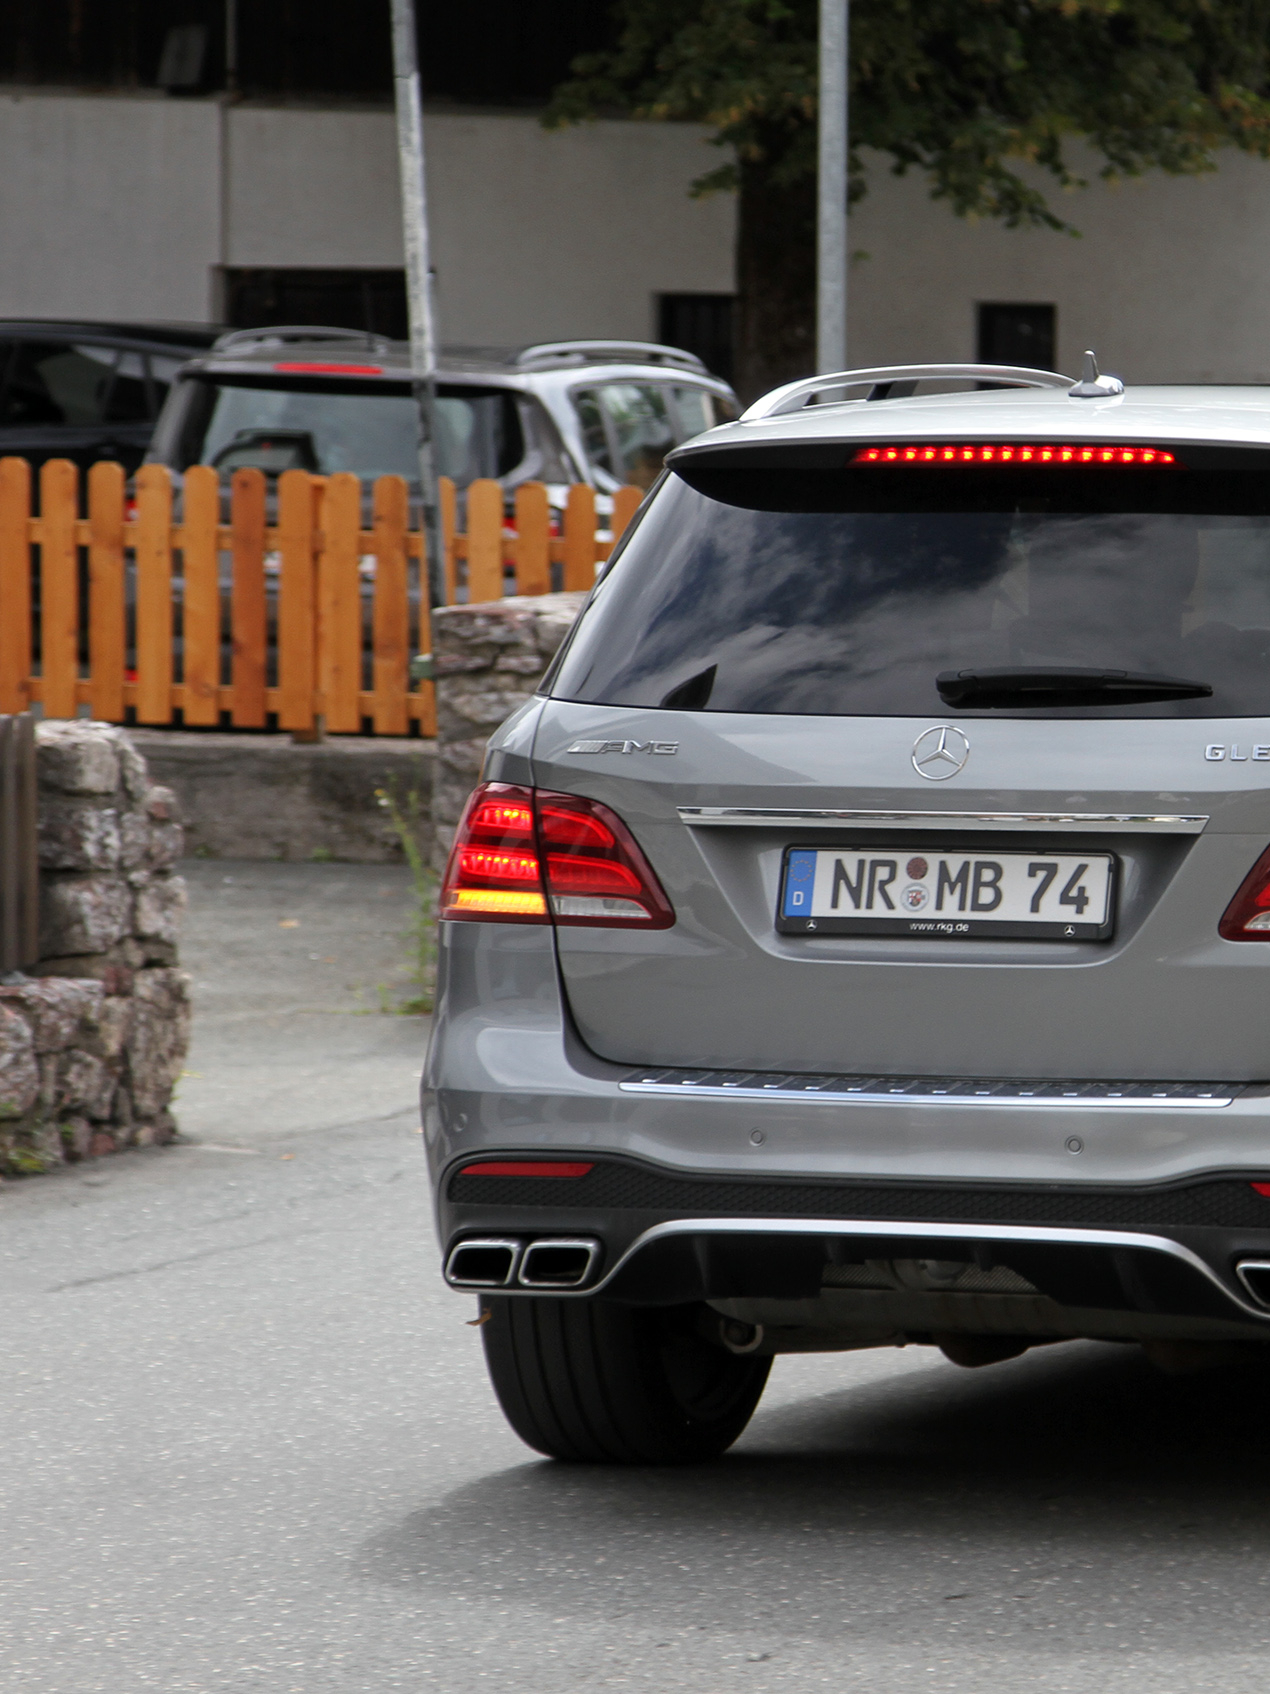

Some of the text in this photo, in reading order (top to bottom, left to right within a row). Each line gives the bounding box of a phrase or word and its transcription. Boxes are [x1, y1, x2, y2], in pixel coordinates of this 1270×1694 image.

[601, 740, 679, 755] AMG
[831, 858, 1089, 915] NR MB 74
[792, 891, 804, 906] D
[909, 922, 969, 934] www.rkg.de
